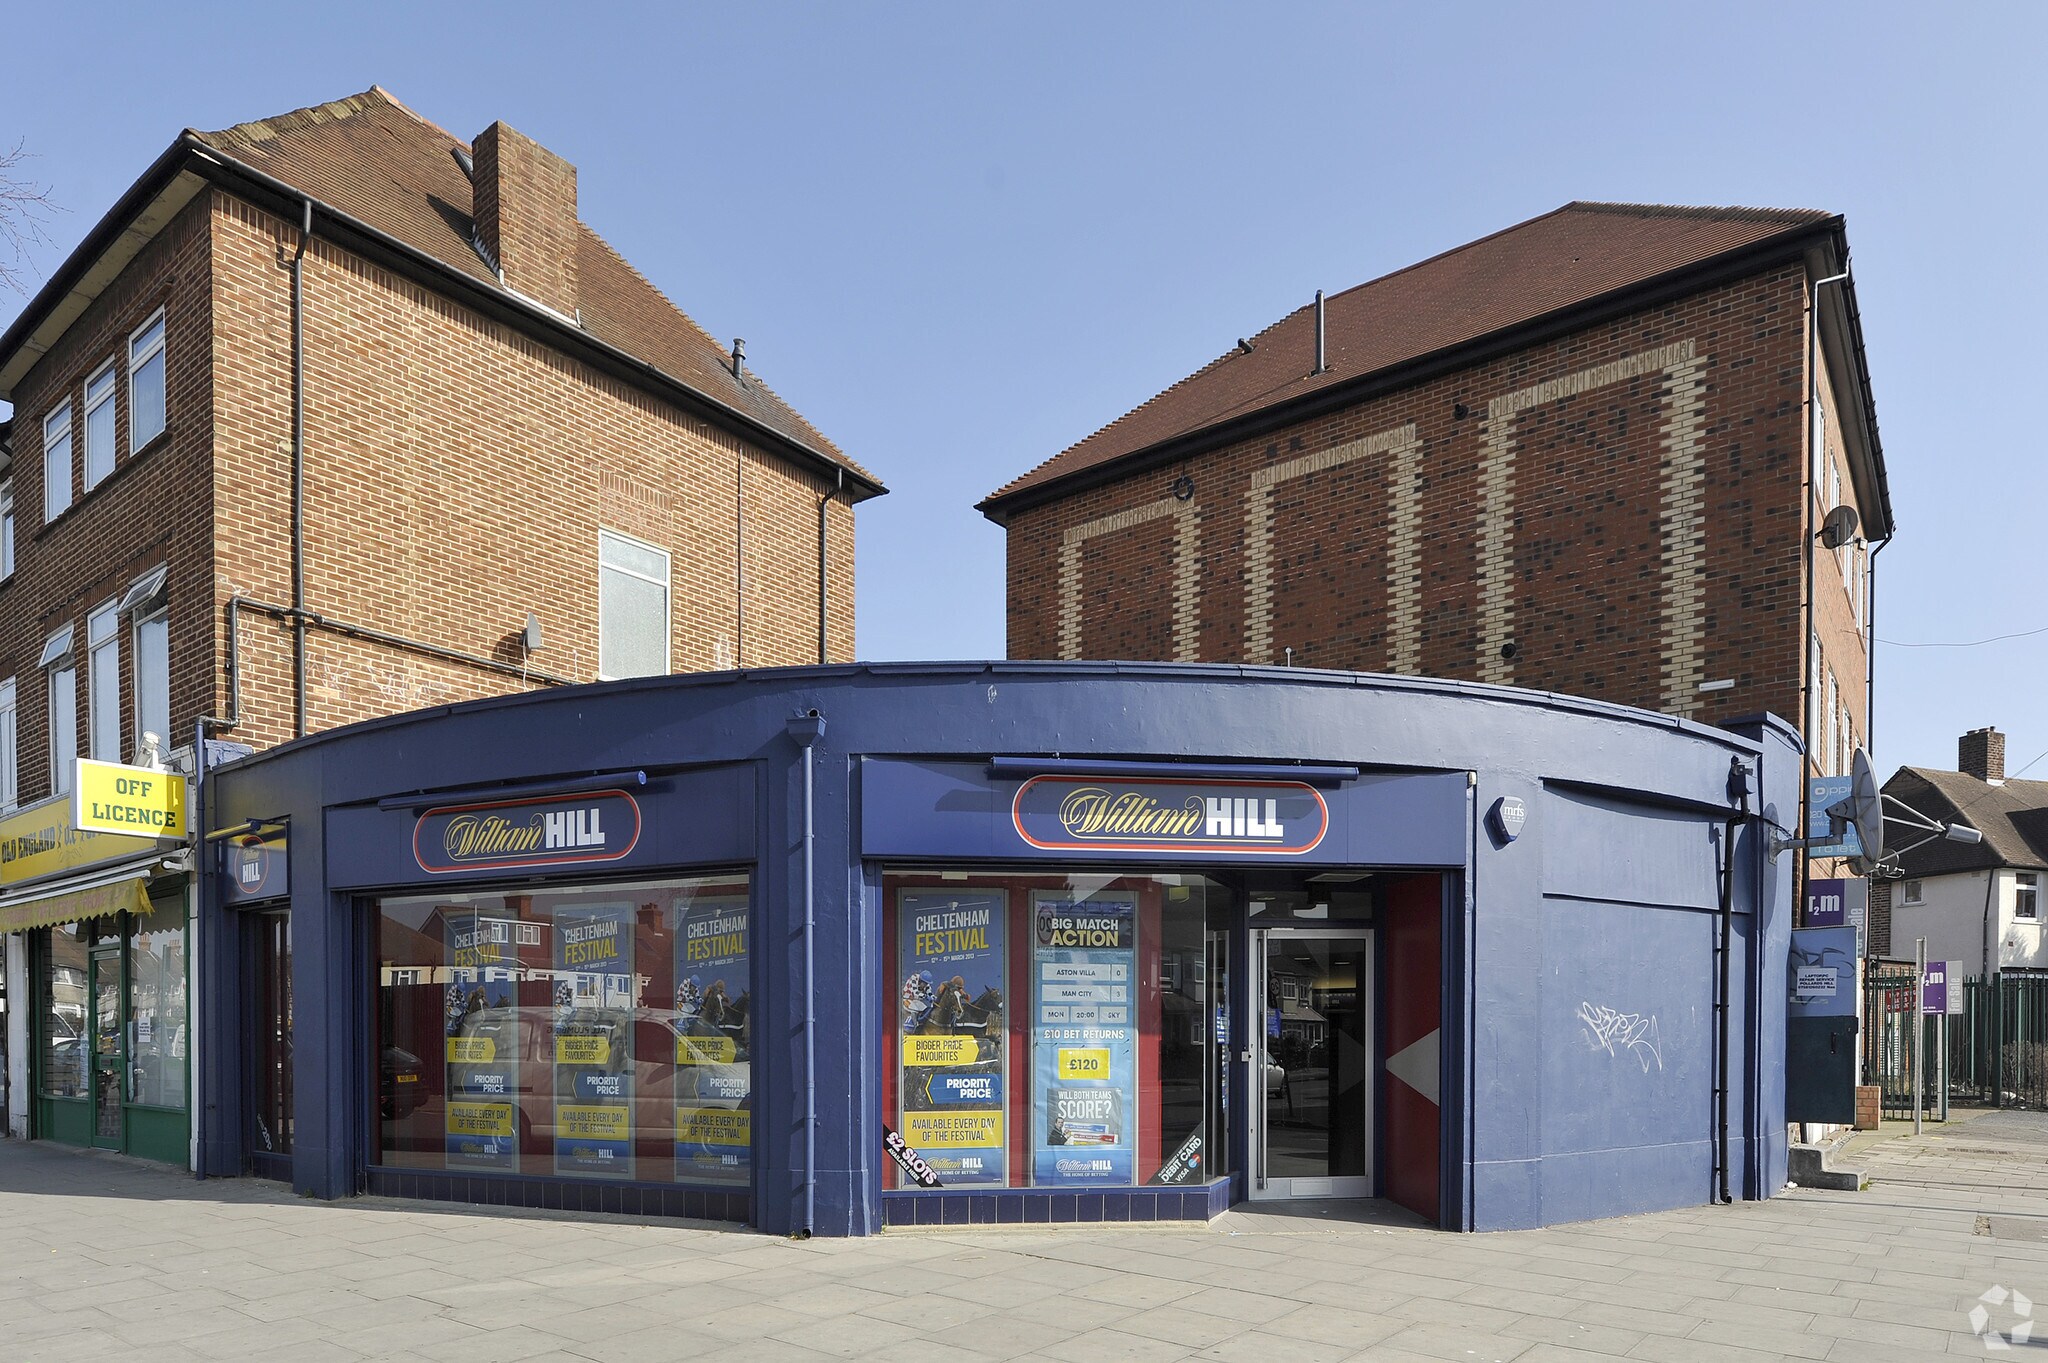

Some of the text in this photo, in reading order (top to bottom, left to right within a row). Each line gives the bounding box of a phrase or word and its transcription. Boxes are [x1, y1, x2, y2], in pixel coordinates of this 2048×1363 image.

[116, 778, 152, 797] OFF
[92, 803, 176, 827] LICENCE
[1059, 787, 1283, 838] William HILL
[1504, 803, 1524, 817] mrfs
[444, 808, 605, 858] William HILL
[2, 838, 16, 863] OLD
[18, 825, 55, 859] ENGLAND
[243, 862, 260, 883] HILL
[916, 909, 989, 932] CHELTENHAM
[1051, 918, 1119, 930] BIG MATCH
[565, 920, 618, 943] CHELTENHAM
[687, 915, 747, 938] CHELTENHAM
[916, 927, 989, 956] FESTIVAL
[1050, 929, 1119, 947] ACTION
[565, 937, 618, 965] FESTIVAL
[687, 933, 746, 961] FESTIVAL
[1044, 1029, 1125, 1040] £10 BET RETURNS
[916, 1040, 963, 1050] BIGGER PRICE
[916, 1052, 959, 1061] FAVOURITES
[1069, 1058, 1098, 1070] £120
[474, 1075, 503, 1084] PRIORITY
[587, 1077, 619, 1085] PRIORITY
[709, 1078, 745, 1088] PRIORITY
[946, 1078, 991, 1089] PRIORITY
[483, 1085, 504, 1093] PRICE
[597, 1086, 619, 1094] PRICE
[720, 1088, 746, 1098] PRICE
[960, 1089, 991, 1099] PRICE
[1058, 1090, 1112, 1100] WILL BOTH TEAMS
[452, 1109, 507, 1119] AVAILABLE EVERY DAY
[1058, 1100, 1112, 1119] SCORE?
[562, 1111, 623, 1122] AVAILABLE EVERY DAY
[683, 1115, 750, 1127] AVAILABLE EVERY DAY
[459, 1120, 500, 1130] OF THE FESTIVAL
[569, 1123, 616, 1134] OF THE FESTIVAL
[912, 1118, 996, 1129] AVAILABLE EVERY DAY
[691, 1127, 740, 1139] OF THE FESTIVAL
[922, 1130, 985, 1141] OF THE FESTIVAL
[484, 1145, 498, 1154] HILL
[598, 1149, 614, 1159] HILL
[722, 1155, 738, 1165] HILL
[886, 1131, 938, 1185] £2 SLOTS
[962, 1157, 983, 1168] HILL
[1161, 1159, 1182, 1182] DEBIT
[1180, 1137, 1202, 1161] CARD
[1092, 1160, 1112, 1170] HILL
[1175, 1167, 1190, 1182] VISA
